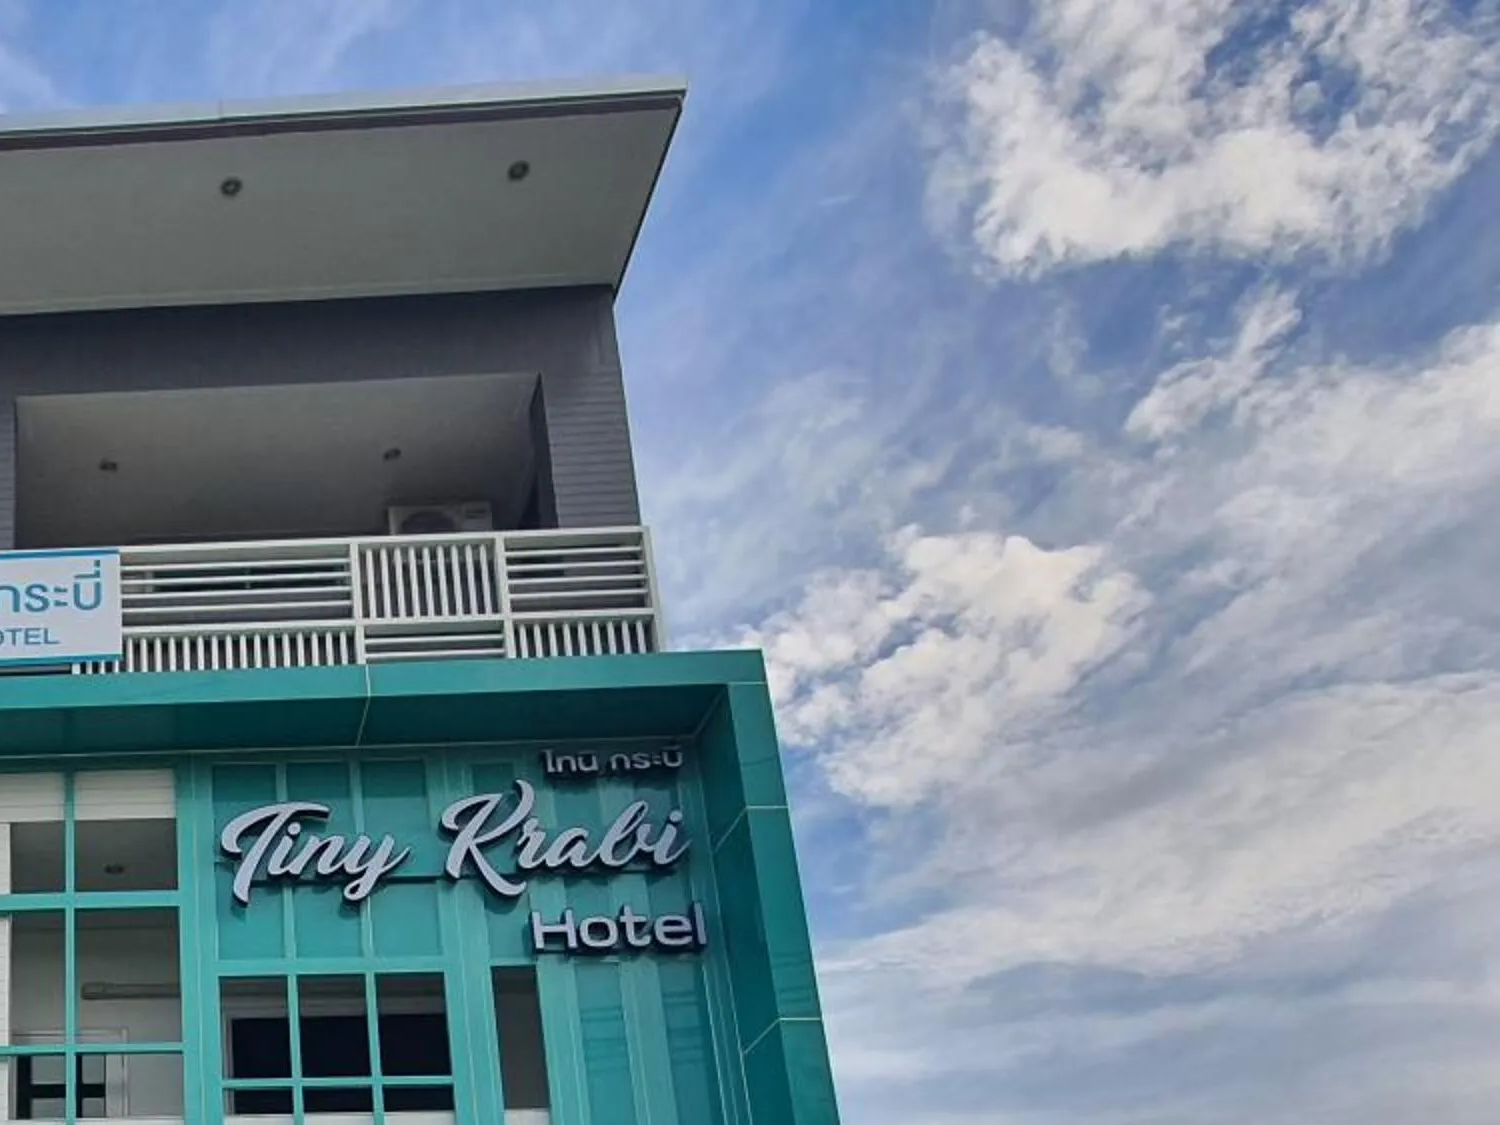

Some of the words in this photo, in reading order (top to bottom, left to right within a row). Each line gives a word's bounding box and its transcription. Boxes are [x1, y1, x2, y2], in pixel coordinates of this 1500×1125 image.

[220, 802, 411, 903] Tiny
[441, 780, 691, 896] Krabi
[531, 902, 707, 950] Hotel
